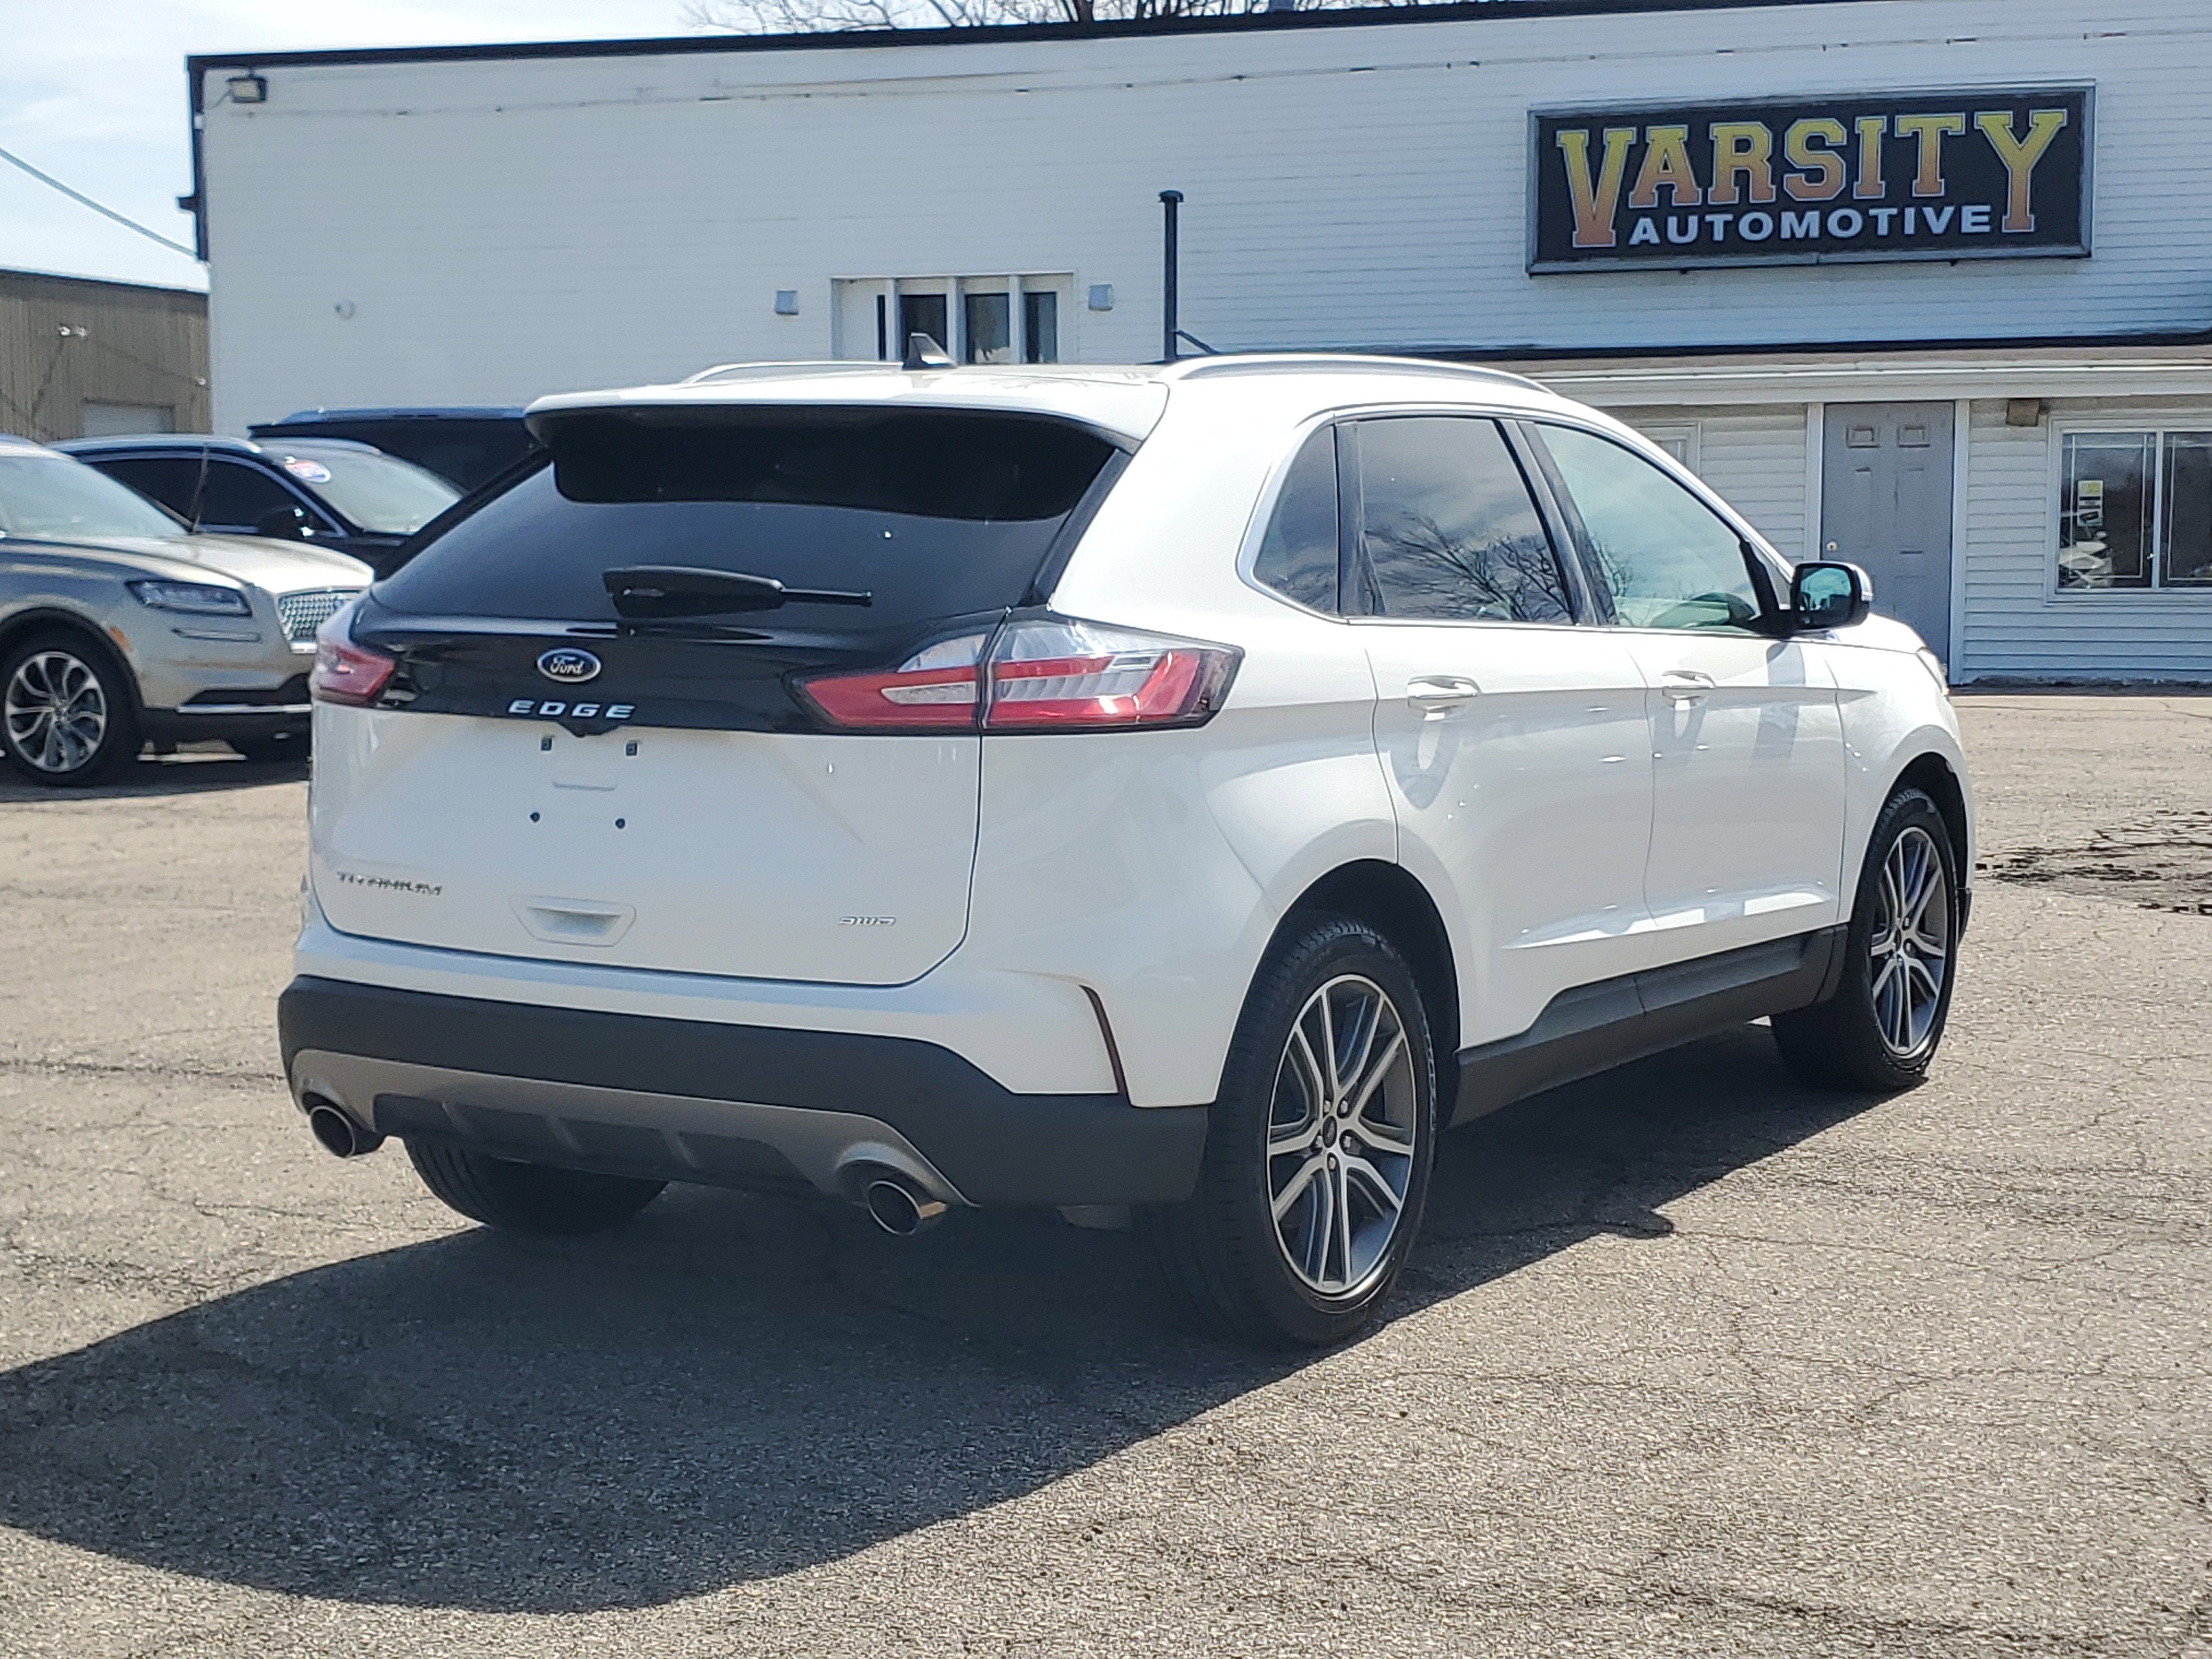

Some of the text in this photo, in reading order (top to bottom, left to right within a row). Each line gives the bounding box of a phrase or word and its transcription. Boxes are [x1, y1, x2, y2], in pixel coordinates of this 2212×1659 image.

[1556, 109, 2068, 247] VARSITY
[1629, 205, 1991, 245] AUTOMOTIVE
[549, 656, 585, 674] Ford
[508, 699, 635, 718] EDGE
